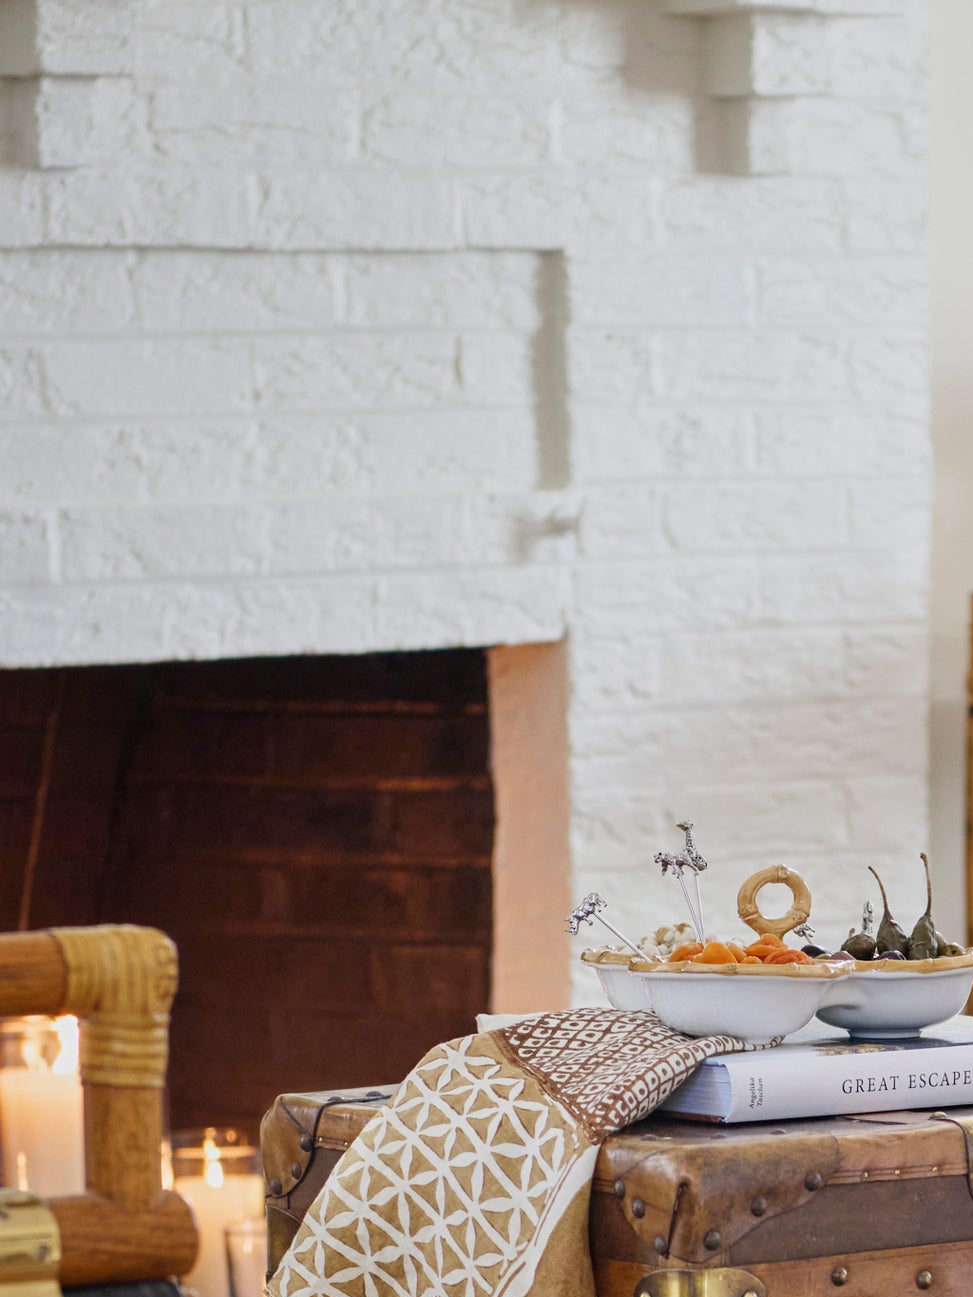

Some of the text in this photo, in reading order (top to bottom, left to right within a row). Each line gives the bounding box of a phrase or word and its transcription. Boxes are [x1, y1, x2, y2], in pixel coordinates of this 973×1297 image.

[748, 1077, 757, 1109] Angelika
[756, 1078, 764, 1107] Taschen
[841, 1075, 899, 1095] GREAT
